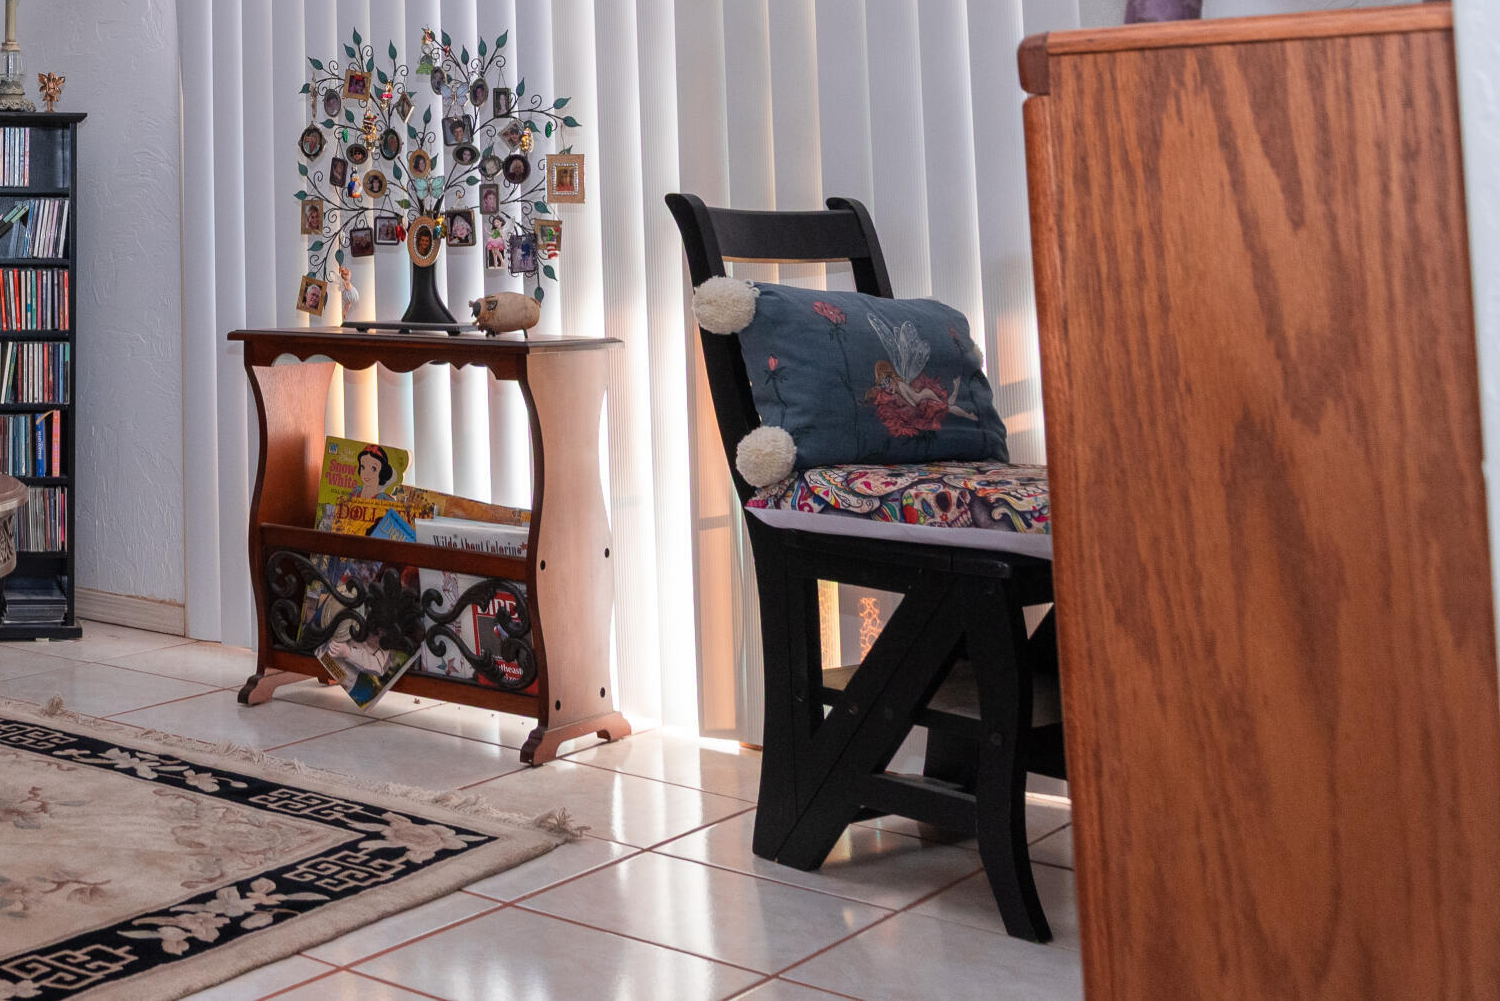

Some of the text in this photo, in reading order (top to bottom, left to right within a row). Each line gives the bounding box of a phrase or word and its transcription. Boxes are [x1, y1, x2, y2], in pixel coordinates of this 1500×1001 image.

[329, 459, 357, 475] Snow
[326, 471, 358, 489] White
[336, 503, 377, 523] DOLL
[460, 538, 483, 553] About
[486, 541, 522, 557] Coloring
